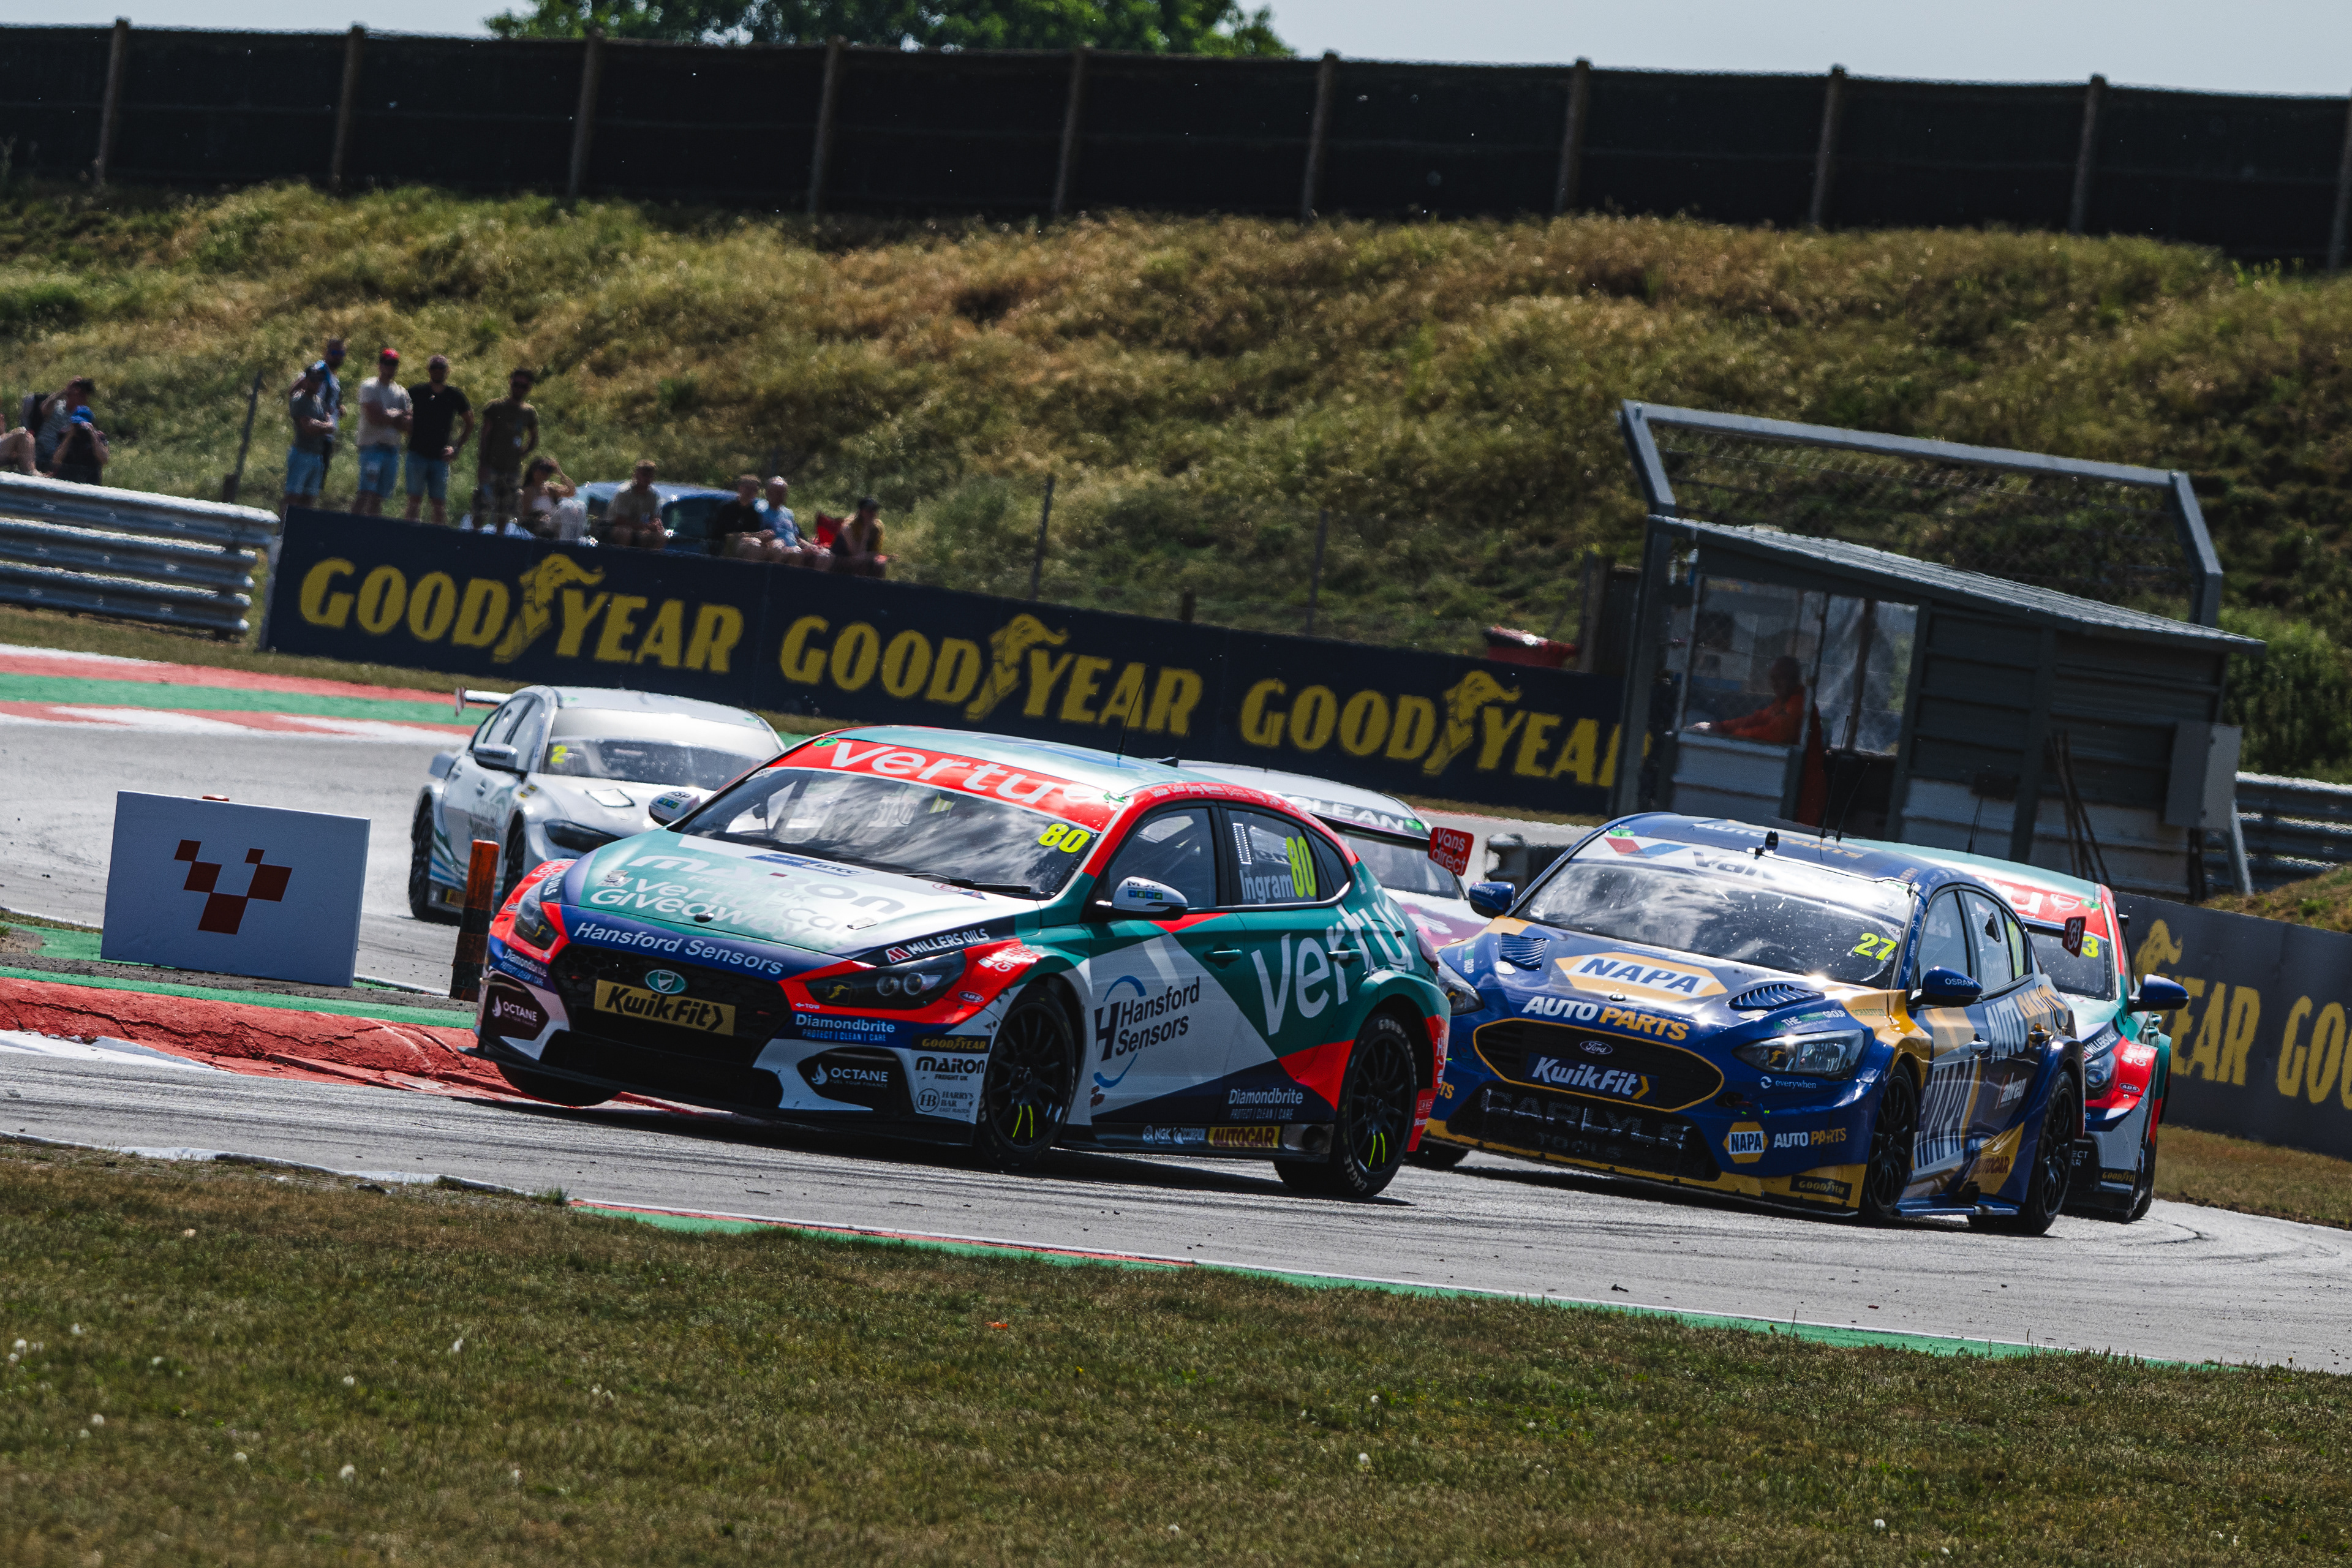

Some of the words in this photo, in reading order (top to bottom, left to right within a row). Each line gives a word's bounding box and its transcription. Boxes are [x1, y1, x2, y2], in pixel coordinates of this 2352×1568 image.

[299, 554, 744, 674] GOODYEAR
[778, 614, 1204, 737] GOODYEAR
[1038, 823, 1091, 853] 80
[1436, 827, 1466, 850] Vans
[1286, 835, 1317, 898] 80
[1432, 846, 1466, 875] direct
[1240, 869, 1295, 904] Ingram
[573, 922, 683, 952] Hansford
[685, 939, 784, 975] Sensors
[906, 932, 964, 955] MILLERS
[964, 928, 990, 947] OILS
[1853, 932, 1898, 961] 27
[2082, 935, 2100, 959] 3
[1579, 957, 1702, 993] NAPA
[1945, 978, 1974, 988] OSRAM
[503, 1001, 537, 1022] OCTANE
[1120, 976, 1200, 1028] Hansford
[796, 1013, 895, 1033] Diamondbrite
[1522, 995, 1599, 1021] AUTO
[1599, 1006, 1690, 1041] PARTS
[1781, 1016, 1802, 1027] THE
[1822, 1009, 1846, 1019] GROUP
[802, 1028, 833, 1039] PROTECT
[839, 1031, 862, 1041] CLEAN
[869, 1033, 887, 1042] CARE
[921, 1036, 987, 1050] GOODYEAR
[1115, 1015, 1189, 1056] Sensors
[1585, 1041, 1608, 1054] Ford
[2276, 995, 2352, 1110] GO
[829, 1067, 889, 1082] OCTANE
[1774, 1079, 1817, 1090] everywhen
[941, 1091, 974, 1100] HARRY'S
[1228, 1088, 1303, 1104] Diamondbrite
[1155, 1128, 1172, 1140] NGK
[1213, 1126, 1276, 1147] AUTOCAR
[1730, 1133, 1763, 1152] NAPA
[1773, 1131, 1809, 1148] AUTO
[1810, 1127, 1847, 1145] PARTS
[1798, 1180, 1845, 1194] GOODYEAR
